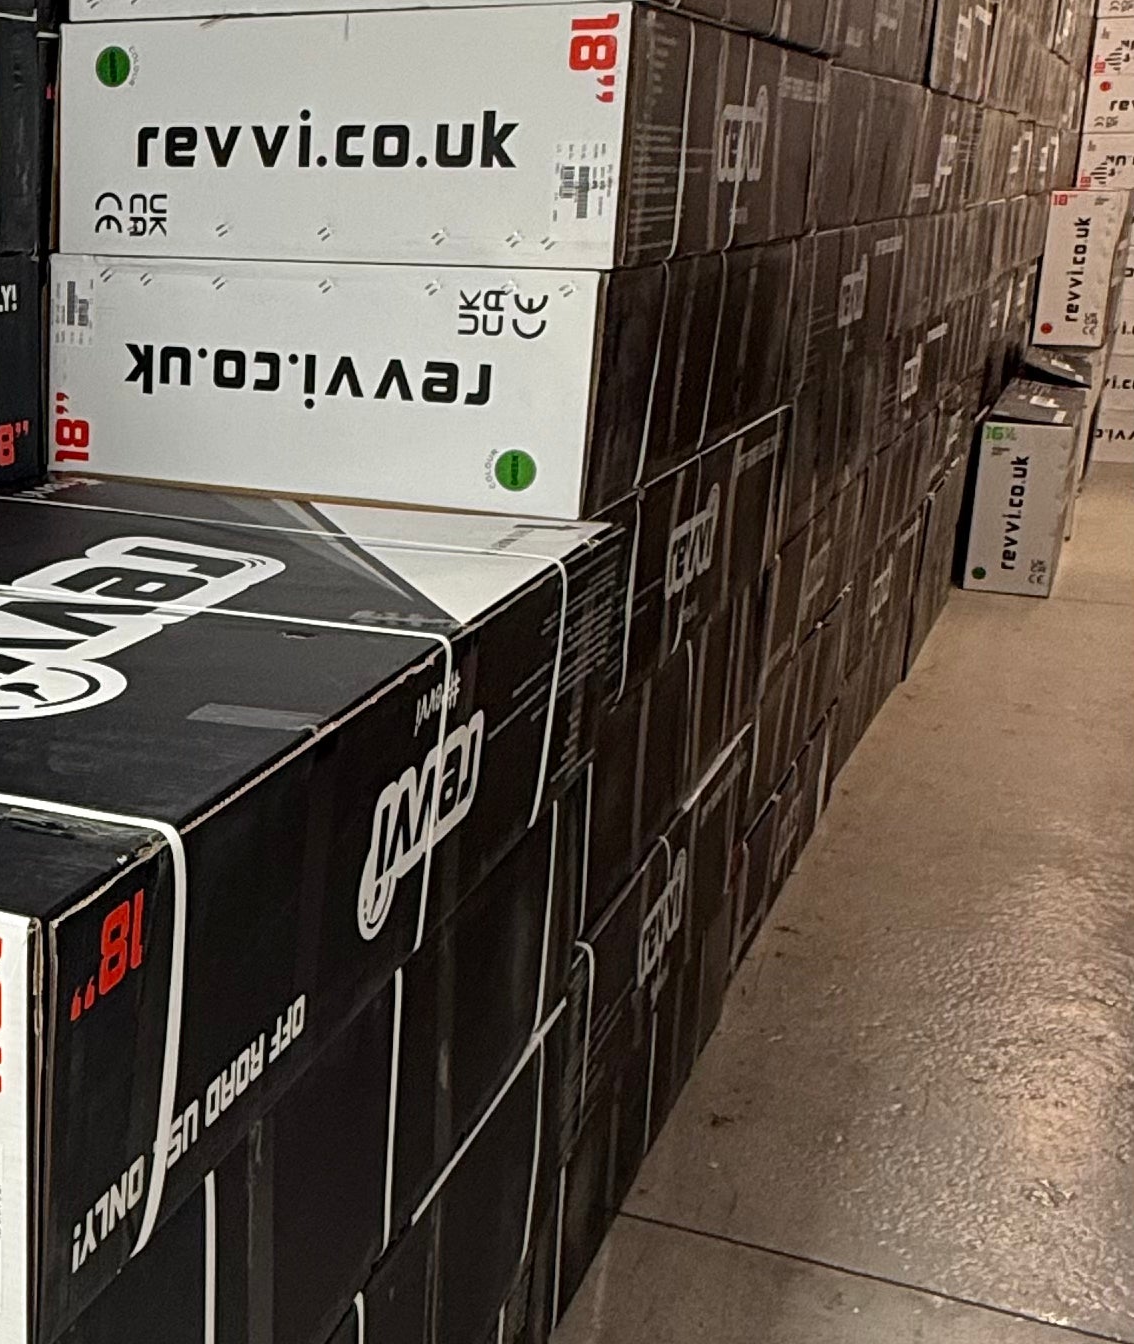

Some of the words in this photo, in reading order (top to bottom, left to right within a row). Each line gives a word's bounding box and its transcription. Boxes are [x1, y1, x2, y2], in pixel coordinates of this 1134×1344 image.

[138, 110, 518, 167] revvi.co.uk
[1065, 218, 1090, 324] revvi.co.uk
[125, 344, 491, 409] revvi.co.uk
[1001, 457, 1029, 570] revvi.co.uk
[269, 993, 306, 1063] OFF
[205, 1033, 265, 1127] ROAD
[152, 1099, 199, 1169] US
[72, 1155, 144, 1273] ONLY!
